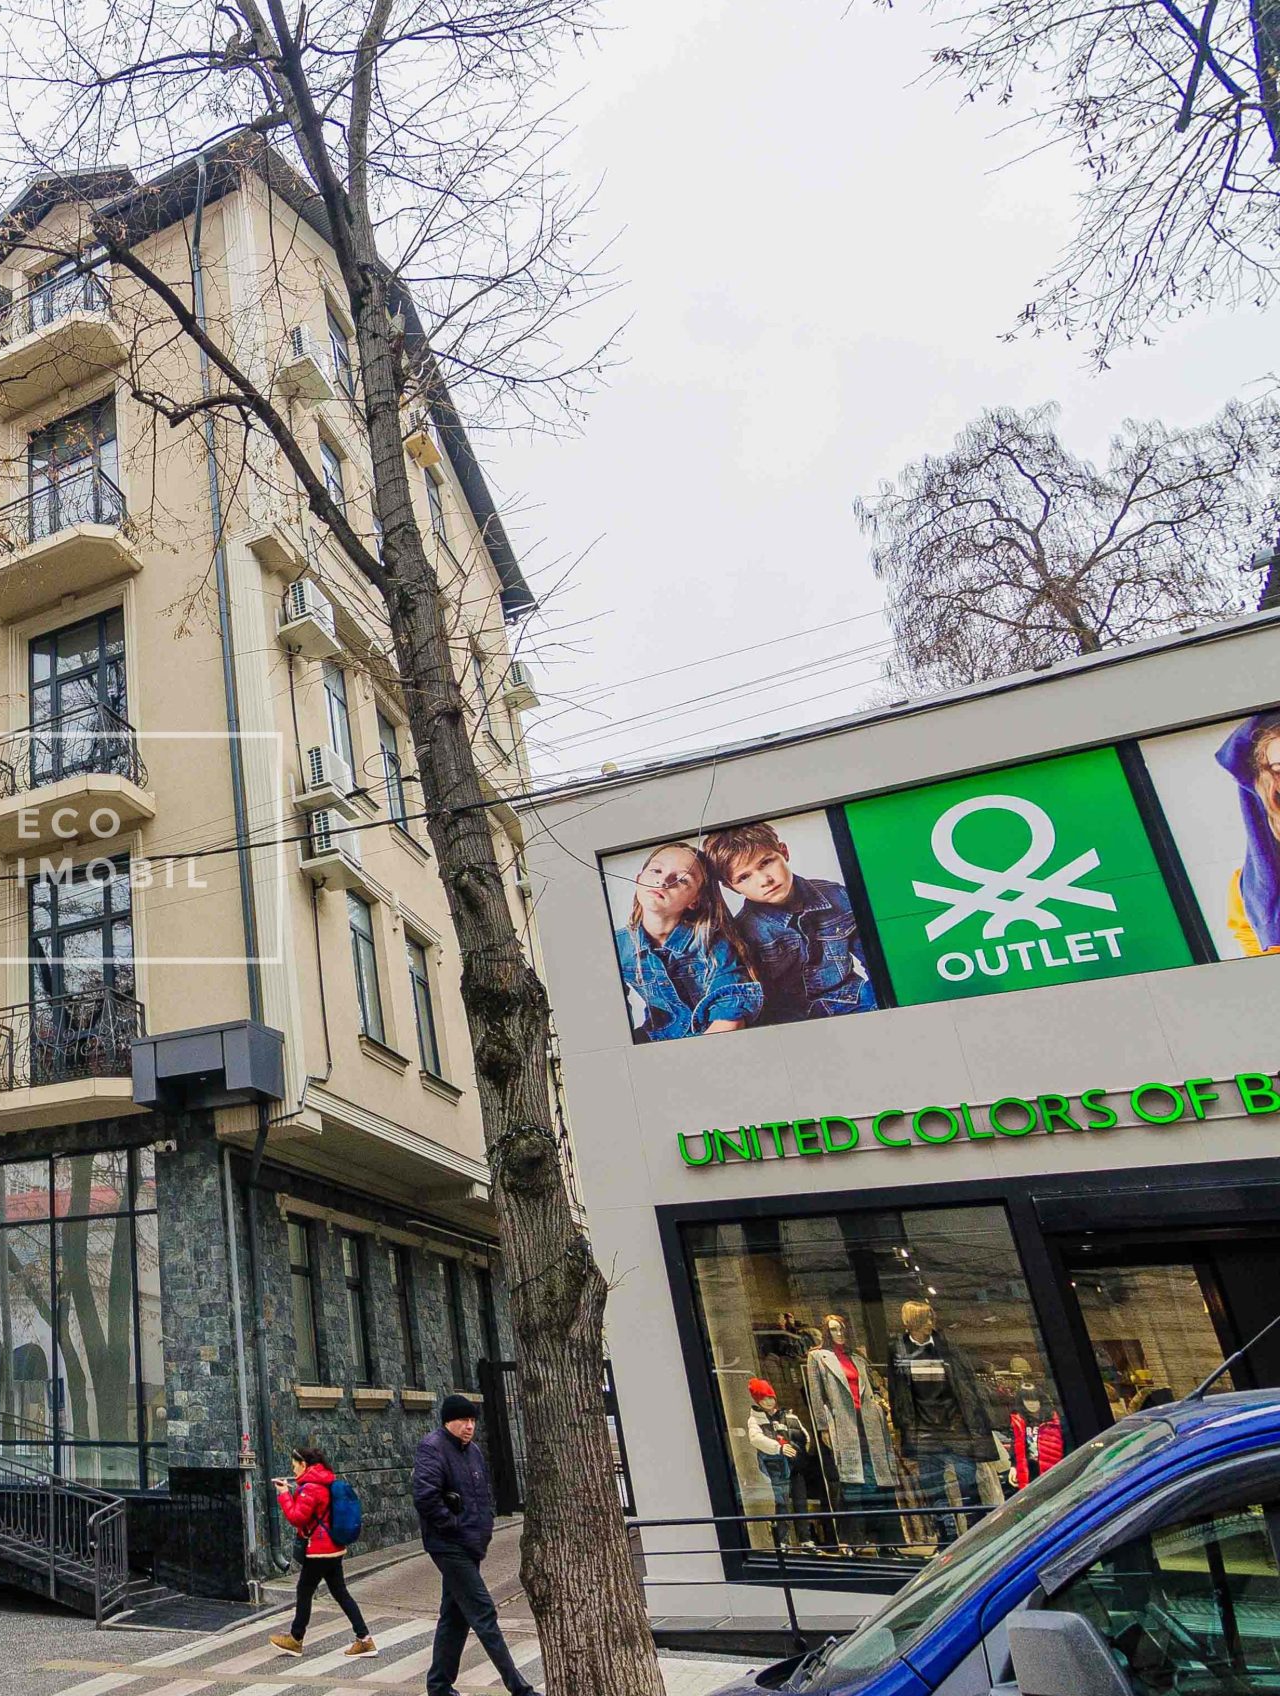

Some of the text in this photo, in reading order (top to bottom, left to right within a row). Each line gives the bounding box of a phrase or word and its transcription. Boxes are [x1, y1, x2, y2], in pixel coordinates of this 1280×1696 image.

[936, 927, 1125, 982] OUTLET
[677, 1115, 860, 1166] UNITED
[872, 1088, 1118, 1148] COLORS
[1130, 1077, 1219, 1126] OF
